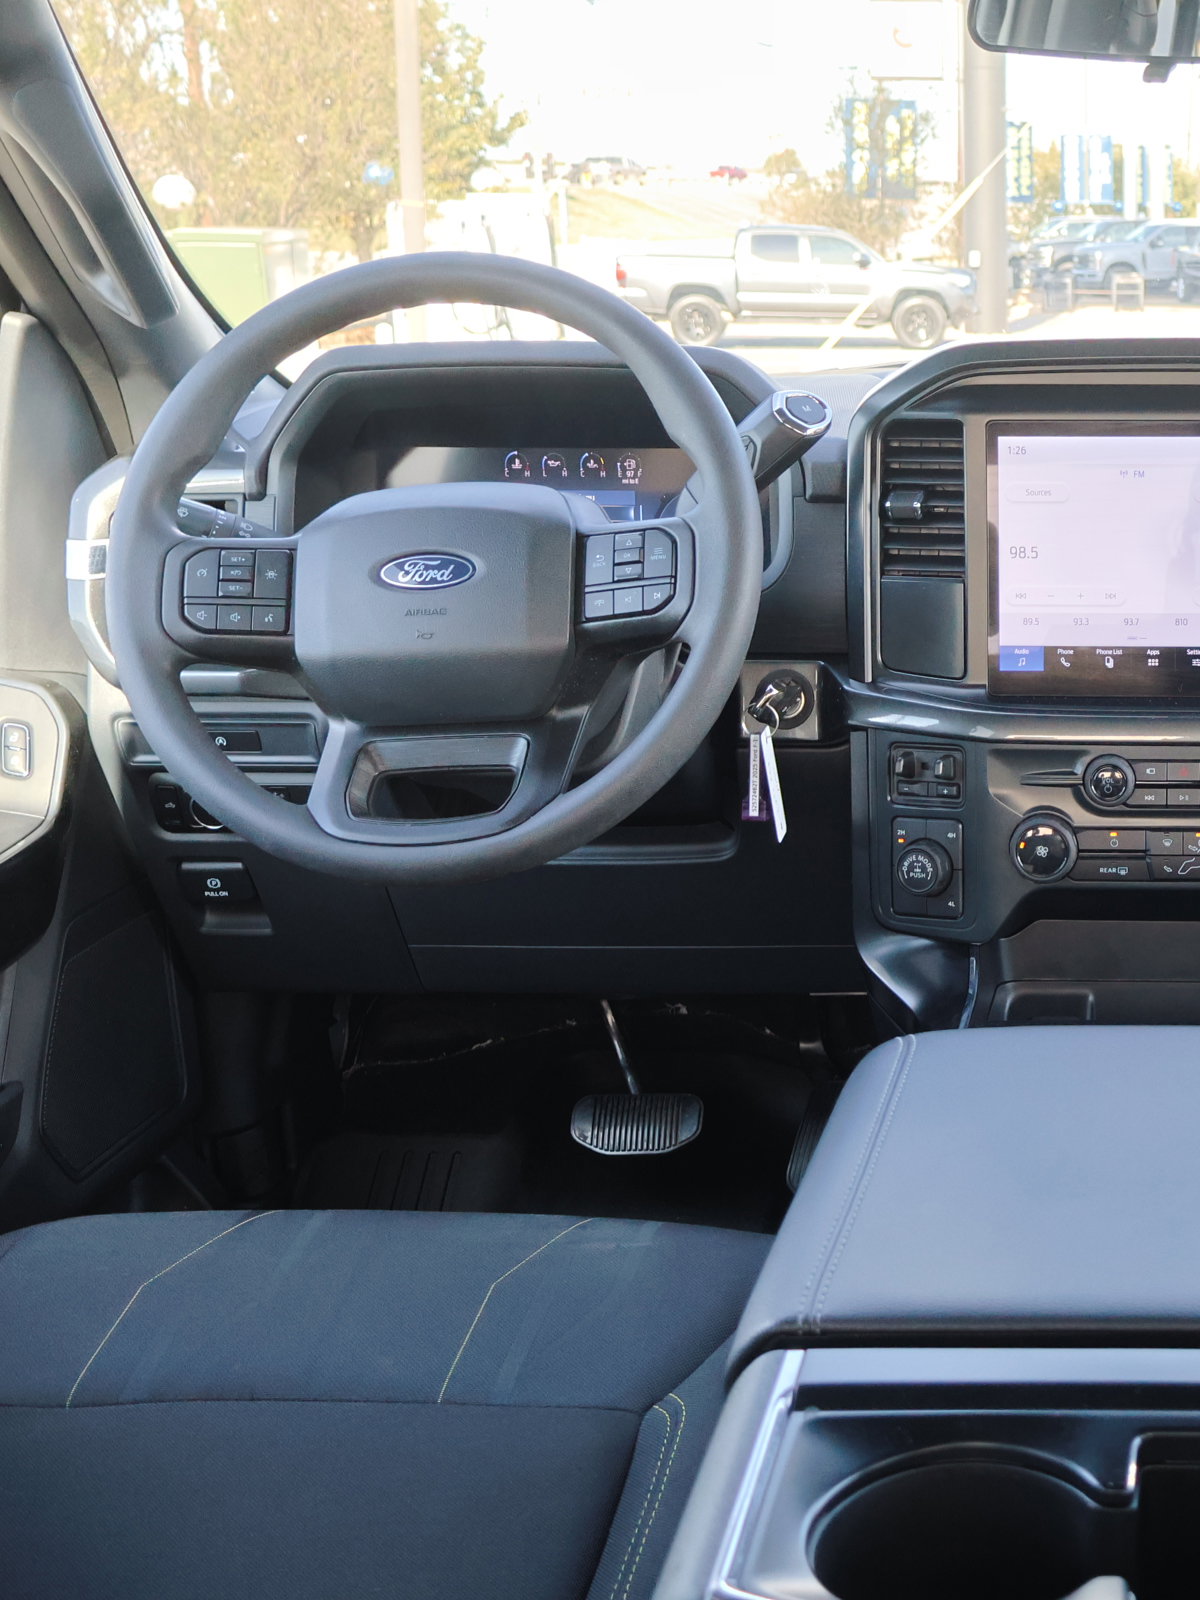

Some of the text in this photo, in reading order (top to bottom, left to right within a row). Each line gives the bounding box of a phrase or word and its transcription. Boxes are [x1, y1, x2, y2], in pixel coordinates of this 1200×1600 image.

[1008, 446, 1026, 455] 1:26
[1025, 488, 1051, 496] Sources
[1009, 546, 1038, 559] 98.5
[398, 560, 455, 582] Ford
[405, 608, 448, 616] AIRBAG
[1022, 618, 1039, 626] 89.5
[1073, 618, 1089, 626] 93.3
[1123, 618, 1139, 626] 93.7
[1175, 618, 1188, 626] 810
[902, 855, 933, 872] DRIVE MODE
